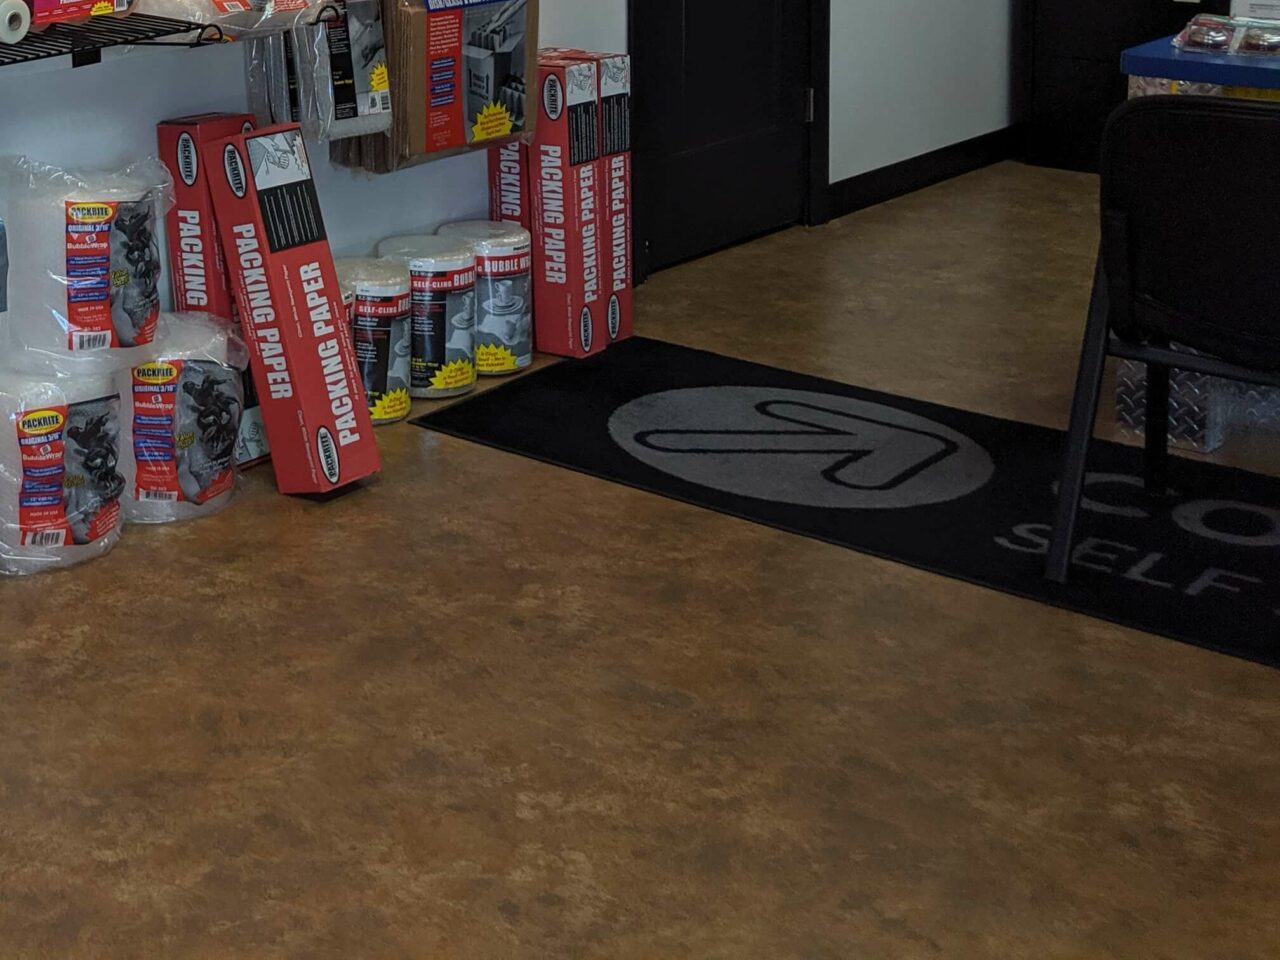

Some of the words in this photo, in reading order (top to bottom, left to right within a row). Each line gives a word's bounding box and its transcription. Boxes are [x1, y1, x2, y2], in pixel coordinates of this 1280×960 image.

[549, 78, 559, 116] PACKRITE
[227, 148, 243, 194] PACKRITE
[499, 141, 520, 216] PACKING
[540, 145, 565, 224] PACKING
[580, 164, 597, 222] PAPER
[612, 156, 625, 213] PAPER
[71, 206, 109, 218] PACKRITE
[178, 210, 208, 307] PACKING
[484, 257, 518, 272] BUBBLE
[544, 226, 566, 284] PAPER
[582, 223, 598, 303] PACKING
[612, 214, 626, 292] PACKING
[232, 223, 276, 325] PACKING
[262, 326, 294, 399] PAPER
[300, 261, 335, 337] PAPER
[136, 367, 174, 378] PACKRITE
[317, 337, 360, 447] PACKING
[22, 415, 60, 427] PACKRITE
[994, 523, 1263, 596] SELF
